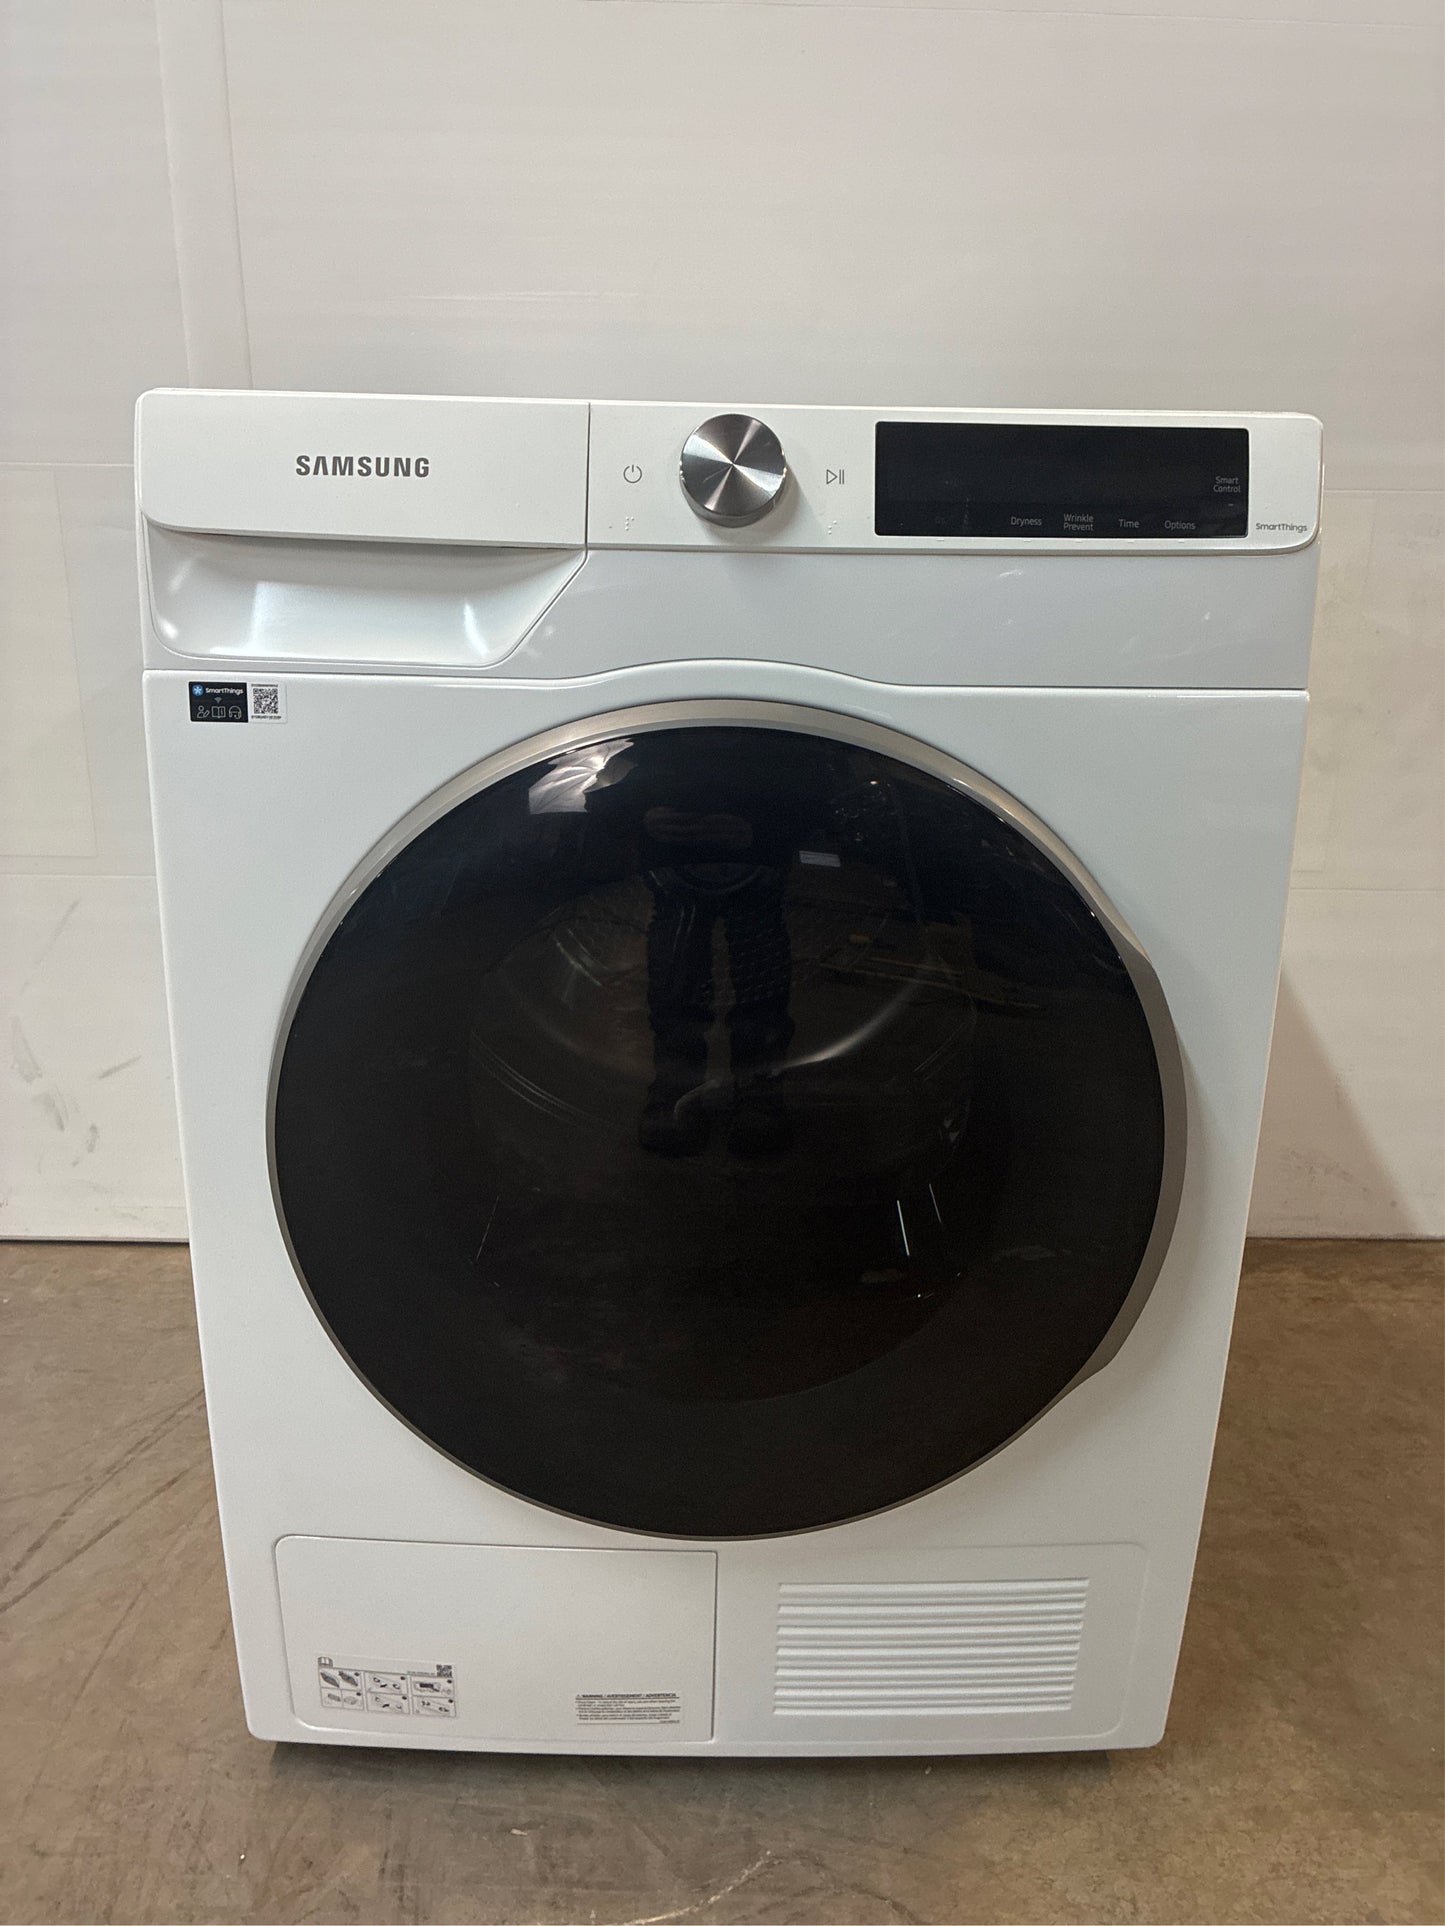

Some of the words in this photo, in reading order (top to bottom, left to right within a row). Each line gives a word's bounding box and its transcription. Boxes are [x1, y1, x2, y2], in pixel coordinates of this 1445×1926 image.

[296, 455, 430, 477] SAMSUNG
[1215, 476, 1239, 485] Smart
[1213, 484, 1241, 493] Control
[1010, 516, 1042, 527] Dryness
[1063, 514, 1094, 523] Wrinkle
[1063, 522, 1094, 531] Prevent
[1118, 519, 1139, 528] Time
[1164, 520, 1196, 530] Options
[1255, 522, 1308, 533] SmartThings
[205, 687, 244, 696] SmartThings
